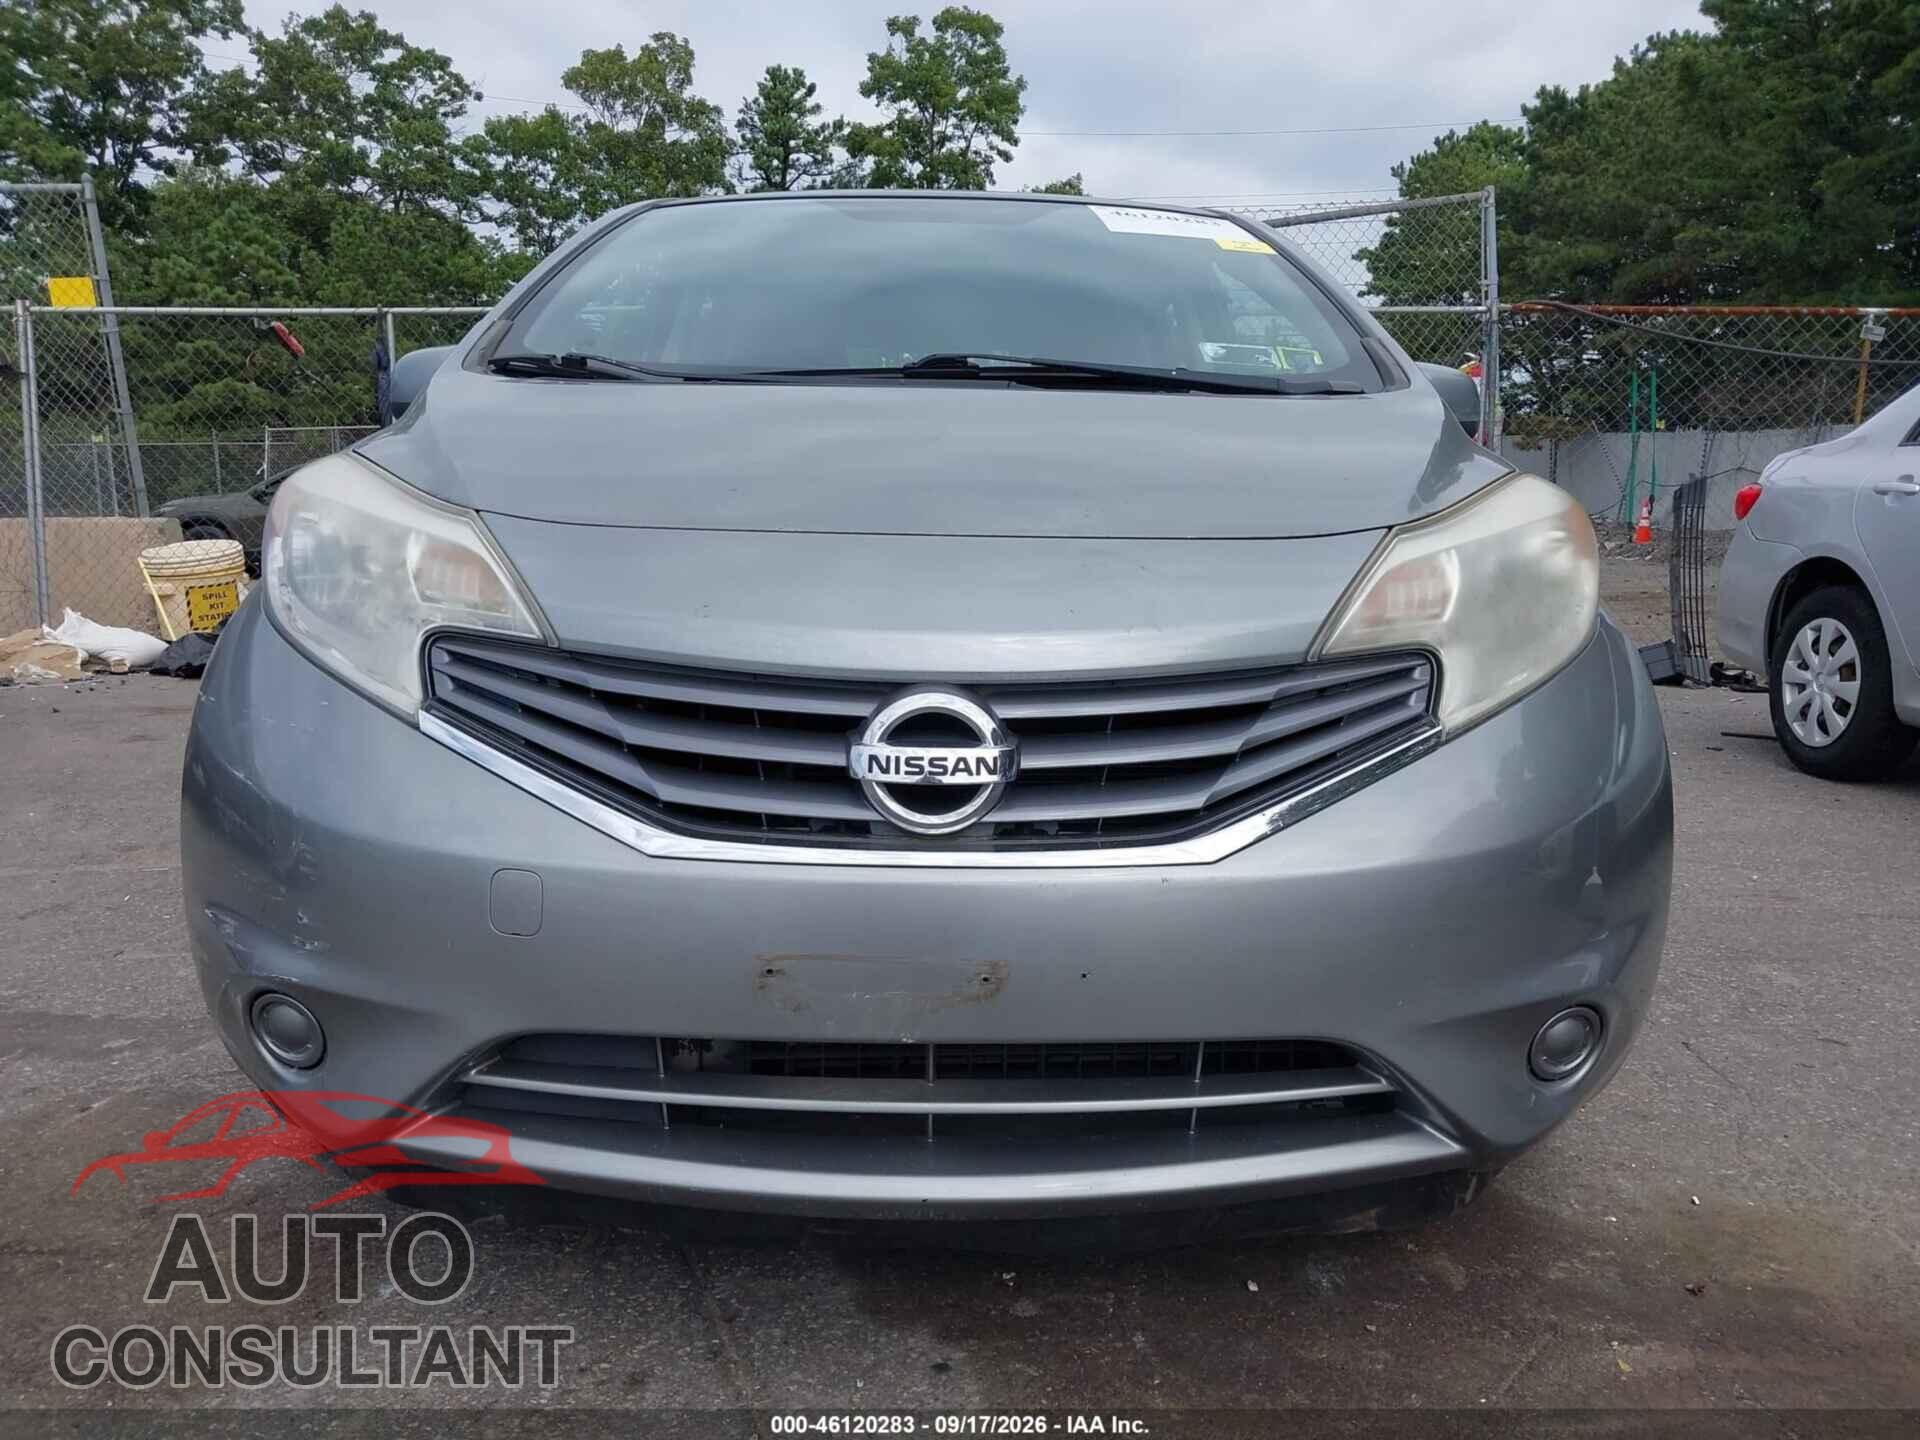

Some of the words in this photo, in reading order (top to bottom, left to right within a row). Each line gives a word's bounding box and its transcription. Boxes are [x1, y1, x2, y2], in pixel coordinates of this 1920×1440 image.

[202, 592, 227, 600] SPILL
[209, 602, 224, 610] KIT
[867, 754, 998, 776] NISSAN
